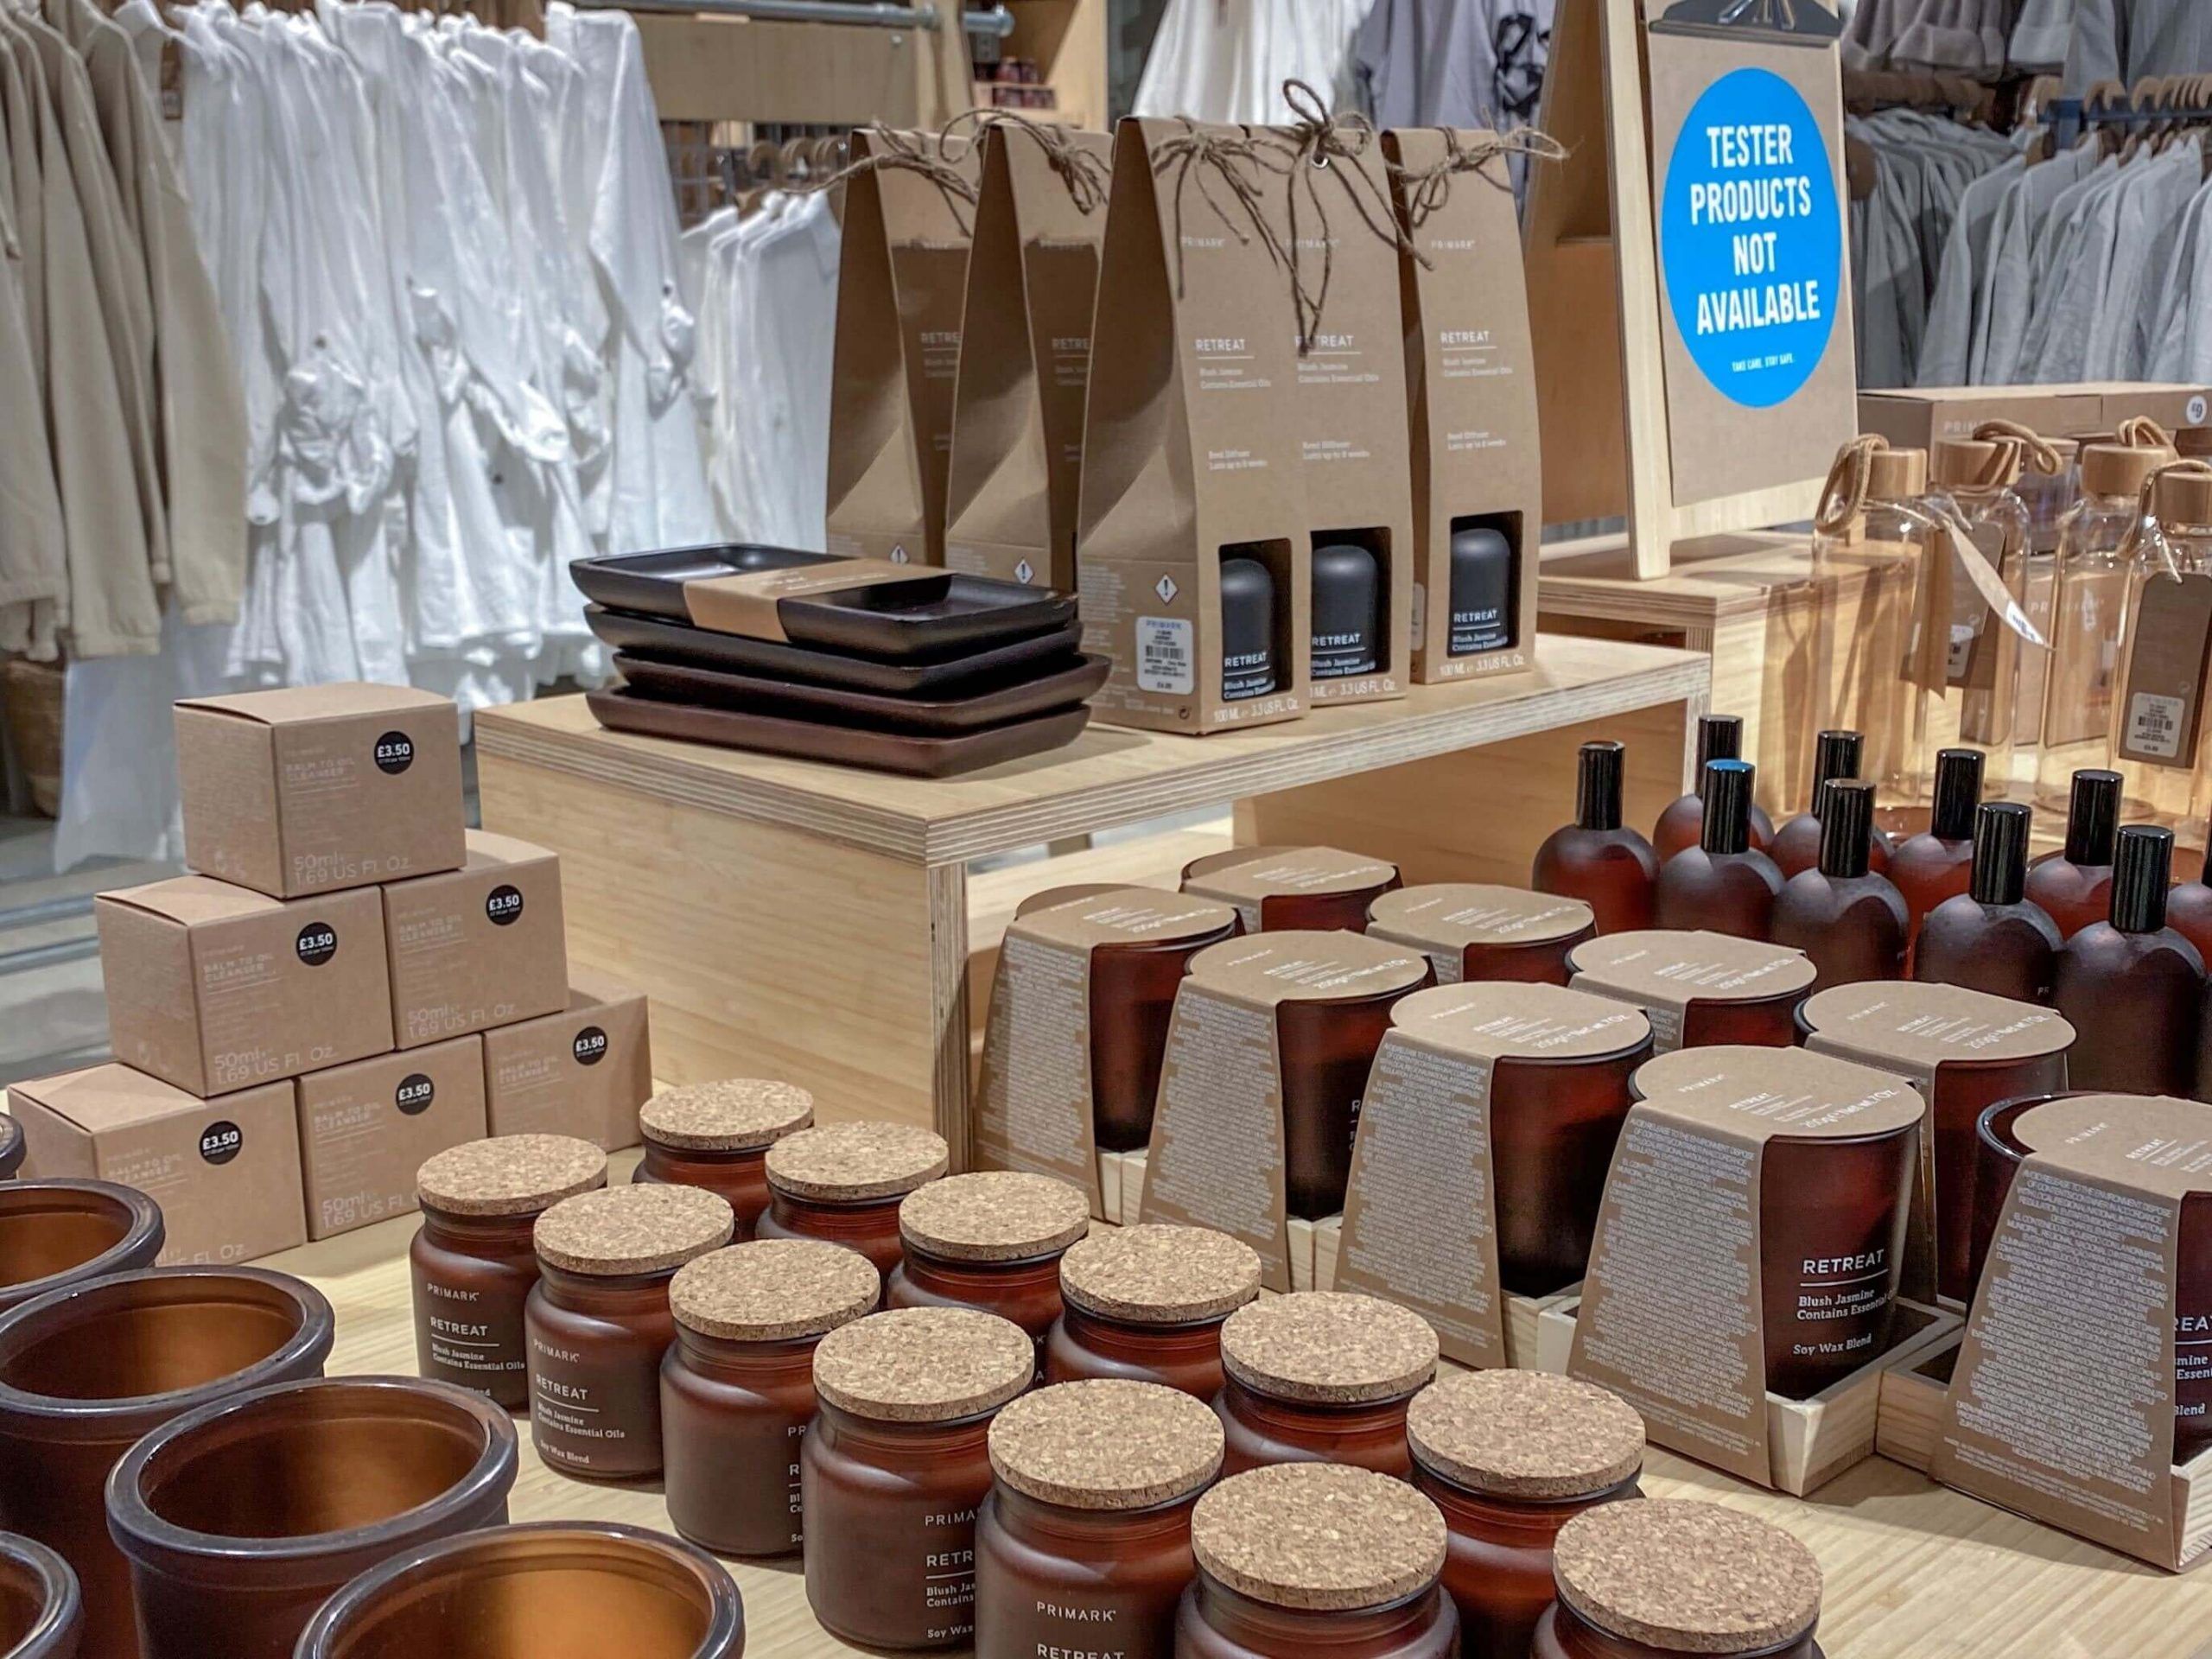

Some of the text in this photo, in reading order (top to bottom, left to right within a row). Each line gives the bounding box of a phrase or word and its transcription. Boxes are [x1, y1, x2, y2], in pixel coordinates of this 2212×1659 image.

[1707, 124, 1794, 168] TESTER
[1690, 175, 1812, 226] PRODUCTS
[1733, 232, 1777, 276] NOT
[1697, 280, 1821, 335] AVAILABLE
[921, 332, 962, 344] RETRE
[1052, 338, 1091, 350] RETRE
[1196, 339, 1245, 352] RETREAT
[1440, 331, 1490, 343] RETREAT
[2191, 403, 2202, 418] £9
[1944, 421, 1980, 432] PRIM
[1453, 609, 1497, 623] RETREAT
[1312, 633, 1361, 646] RETREAT
[1224, 652, 1267, 667] RETREAT
[378, 743, 410, 758] £3.50
[334, 863, 357, 880] US
[489, 894, 519, 911] £3.50
[299, 933, 334, 950] £3.50
[444, 1014, 466, 1031] US
[575, 1035, 605, 1052] £3.50
[256, 1058, 279, 1075] US
[398, 1083, 430, 1101] £3.50
[202, 1130, 238, 1150] £3.50
[360, 1200, 384, 1218] US
[1803, 1249, 1884, 1274] RETREAT
[427, 1283, 478, 1301] PRIMARK
[1798, 1289, 1875, 1307] Blush Jasmine
[1797, 1308, 1848, 1320] Contains
[430, 1316, 487, 1337] RETREAT
[432, 1343, 485, 1361] Blush Jasmine
[533, 1338, 580, 1363] PRIMARK
[1793, 1333, 1872, 1356] Soy Wax Blend
[433, 1353, 525, 1370] Contains Essential Oils
[2175, 1355, 2209, 1366] mine
[2177, 1369, 2212, 1380] Essen
[536, 1374, 588, 1401] RETREAT
[537, 1402, 584, 1426] Blush Jasmine
[538, 1412, 625, 1439] Contains Essential Oils
[550, 1446, 565, 1459] Wax
[567, 1452, 589, 1464] Blend
[925, 1510, 976, 1527] PRIMA
[791, 1534, 803, 1543] So
[926, 1550, 973, 1568] RETR
[926, 1586, 957, 1597] Blush
[926, 1595, 975, 1608] Contains
[1037, 1601, 1114, 1622] PRIMARK
[927, 1624, 974, 1638] Soy Wax
